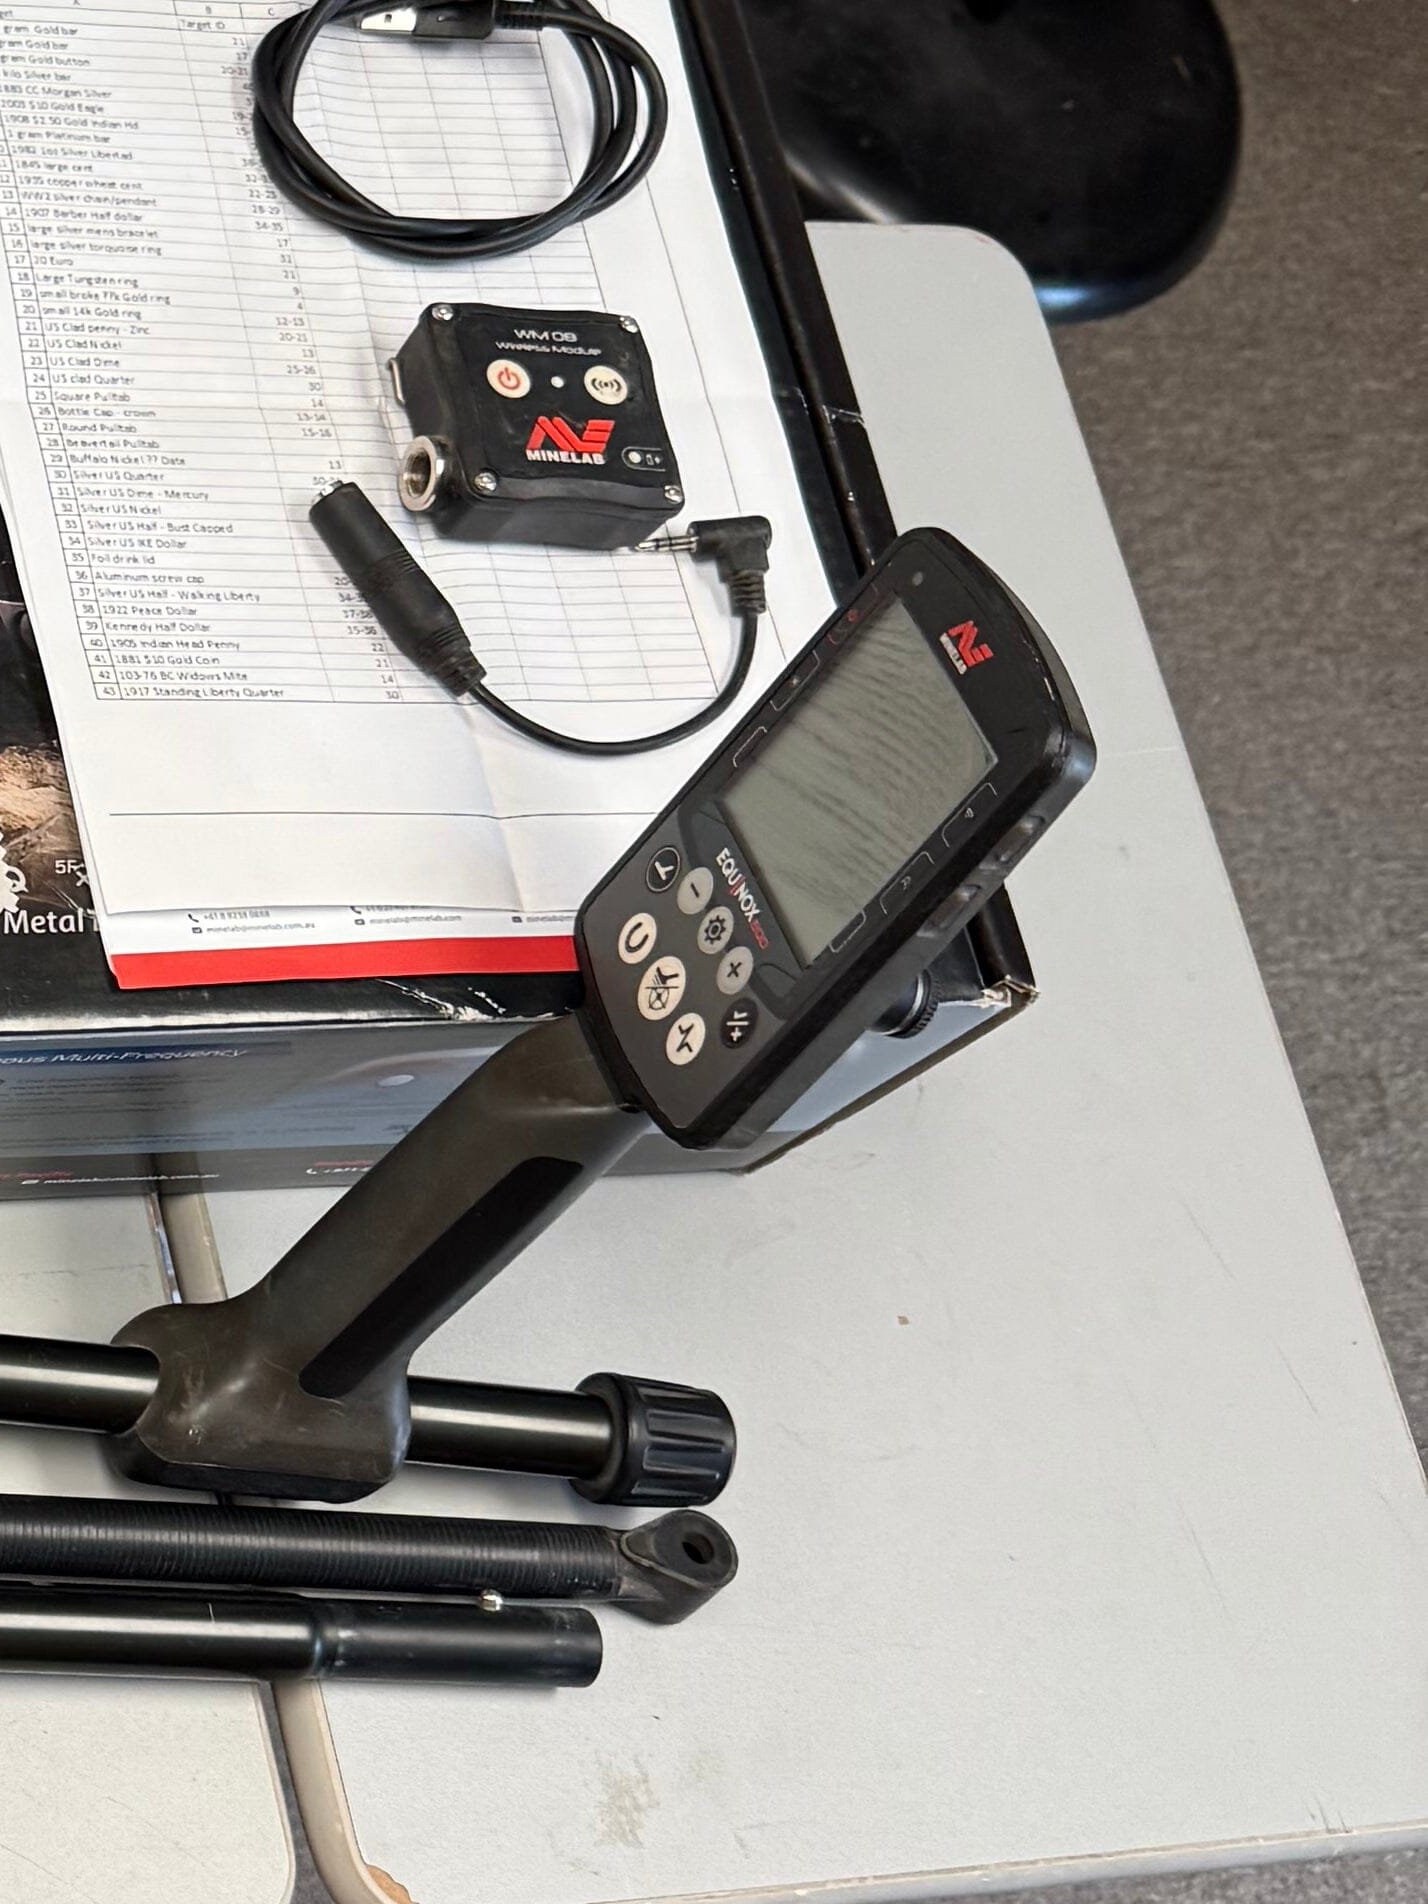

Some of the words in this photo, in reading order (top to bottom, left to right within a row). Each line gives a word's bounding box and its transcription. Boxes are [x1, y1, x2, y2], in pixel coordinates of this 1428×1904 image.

[94, 307, 121, 317] Gold
[514, 329, 549, 341] WM
[525, 449, 606, 465] MINELAB
[166, 655, 193, 665] Gold
[195, 655, 220, 665] Coin
[716, 847, 760, 922] EQUINOX
[3, 907, 84, 935] Metal
[52, 1048, 247, 1063] Multi-Frequency
